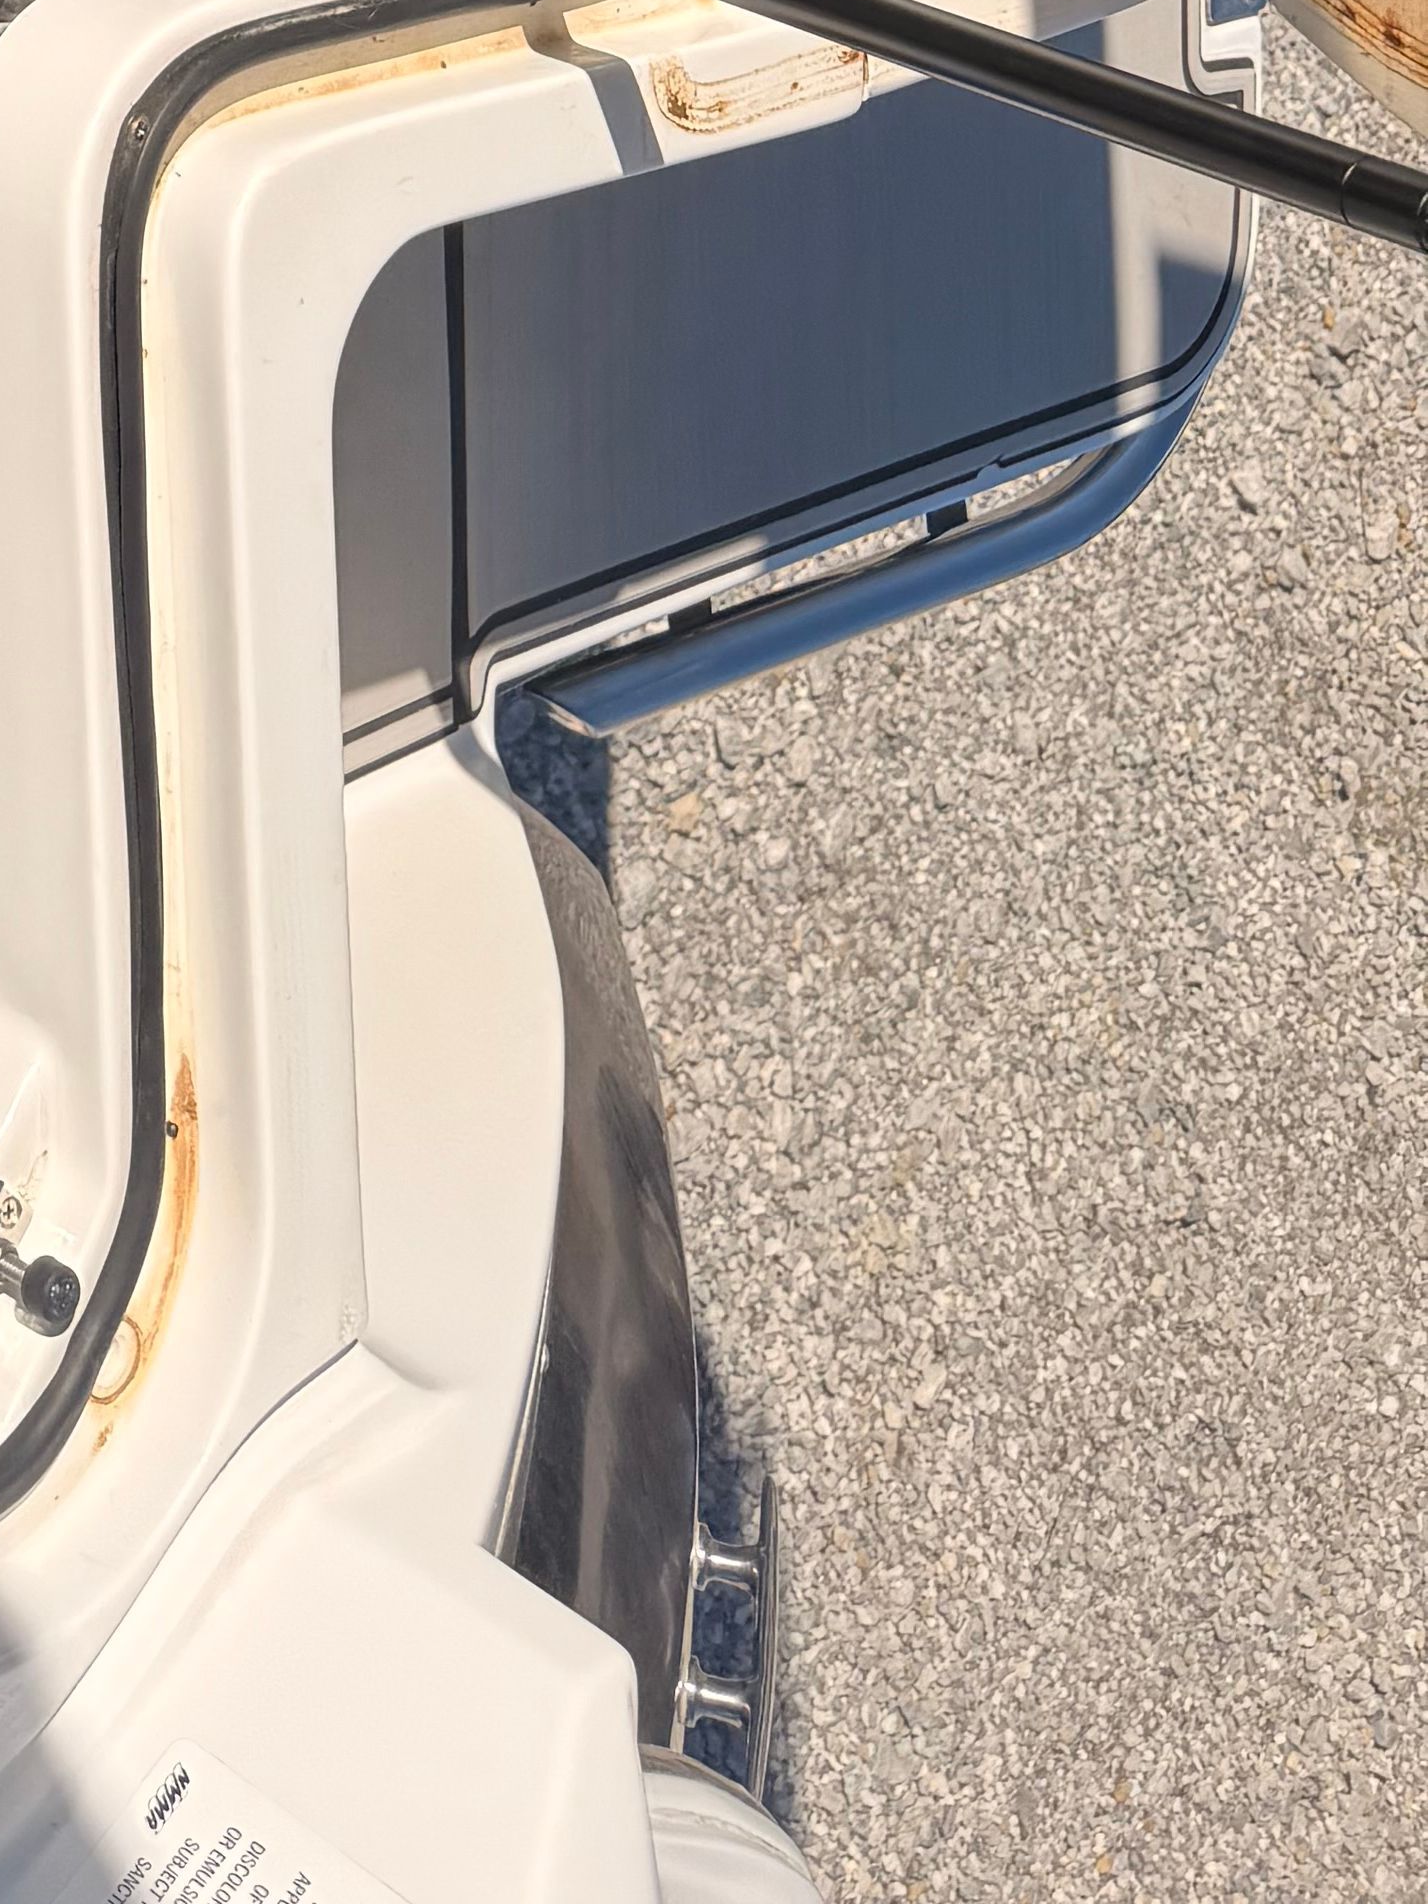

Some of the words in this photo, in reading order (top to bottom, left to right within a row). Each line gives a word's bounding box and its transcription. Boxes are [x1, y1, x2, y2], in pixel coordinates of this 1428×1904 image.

[150, 1837, 200, 1902] SUBJECT
[218, 1827, 243, 1850] OR
[210, 1841, 266, 1904] DISCOLO
